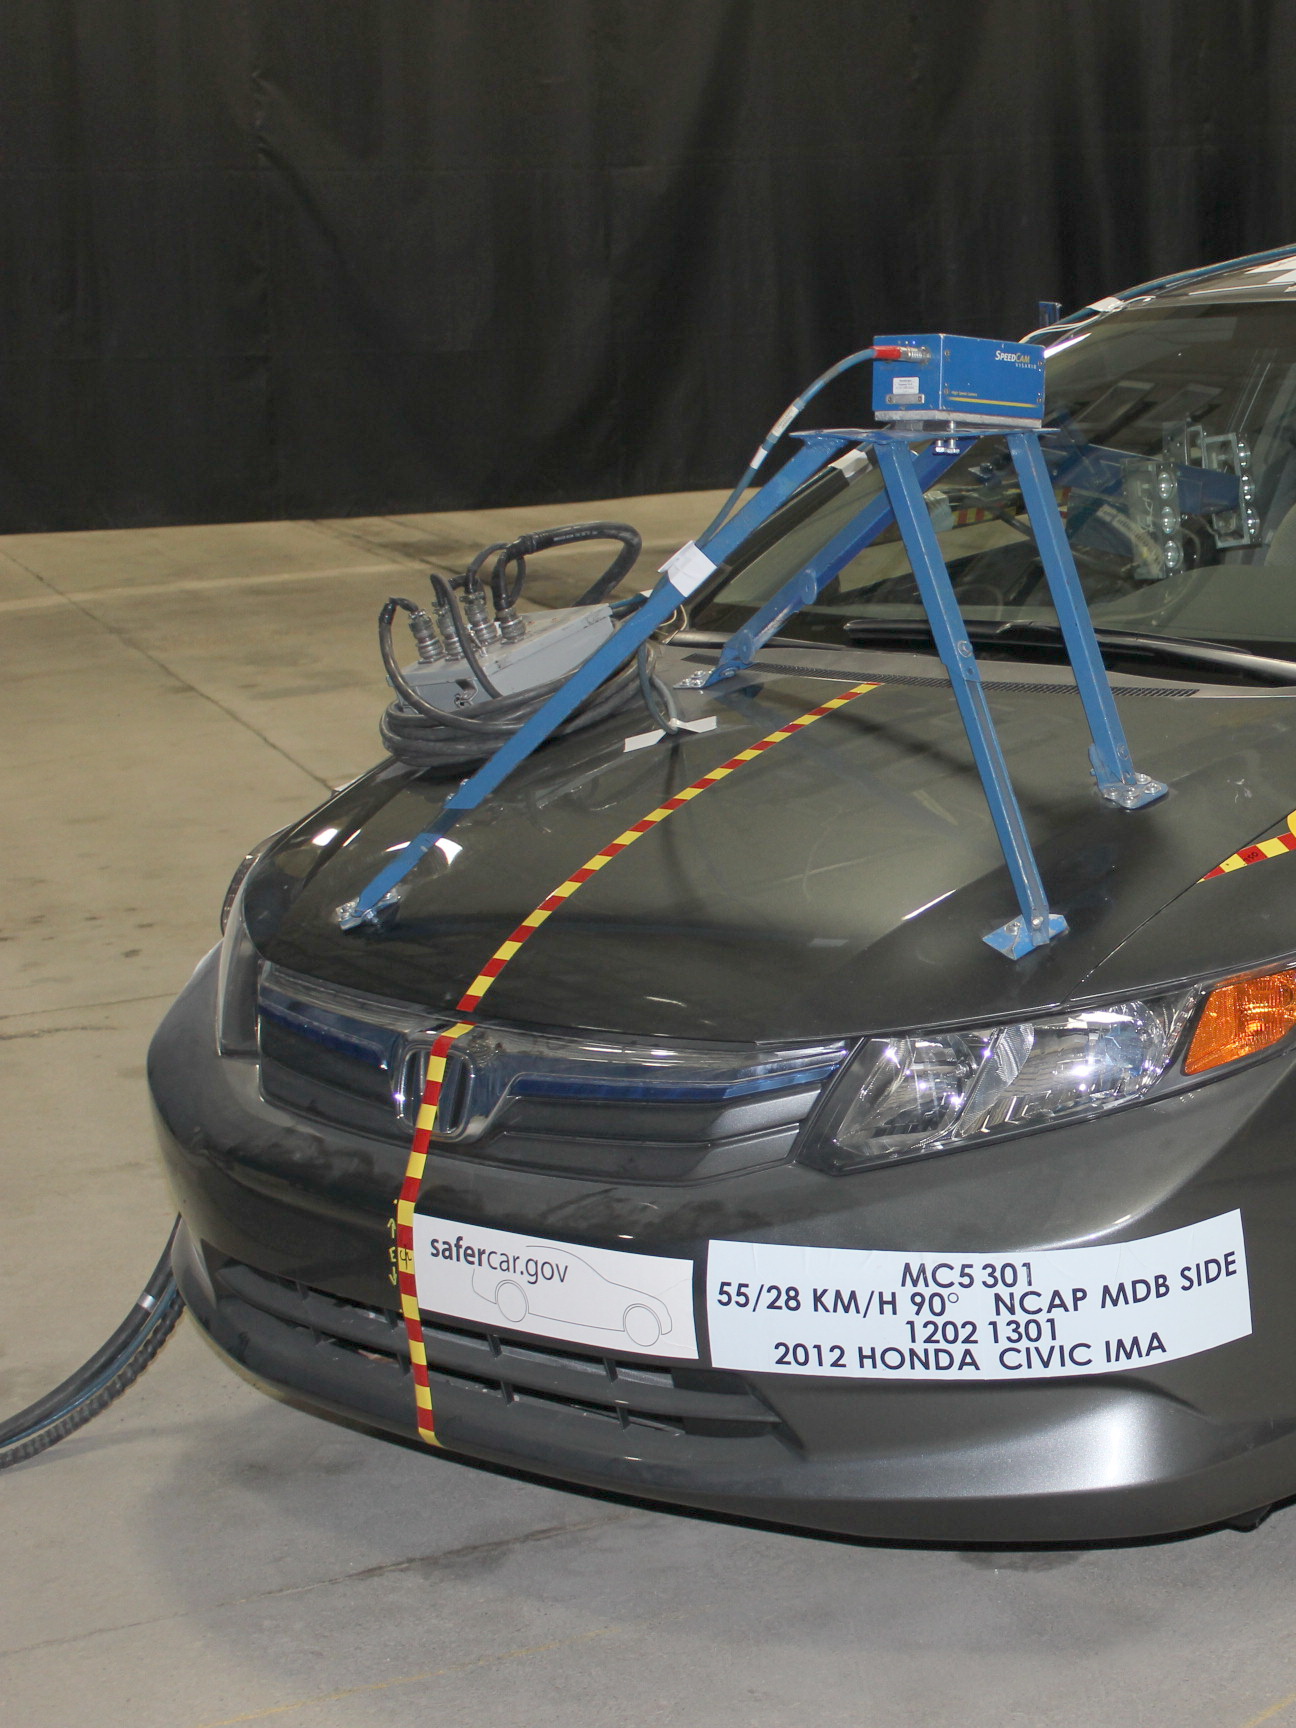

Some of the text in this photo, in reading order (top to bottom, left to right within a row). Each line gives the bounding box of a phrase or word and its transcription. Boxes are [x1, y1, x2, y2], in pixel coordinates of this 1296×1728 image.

[430, 1236, 568, 1285] safercar.gov
[901, 1262, 1033, 1288] MC5301
[717, 1281, 801, 1312] 55/28
[812, 1288, 898, 1318] KM/H
[994, 1288, 1088, 1316] NCAP
[1100, 1274, 1170, 1309] MDB
[1180, 1251, 1237, 1291] SIDE
[774, 1332, 1167, 1371] 2012 HONDA CIVIC IMA
